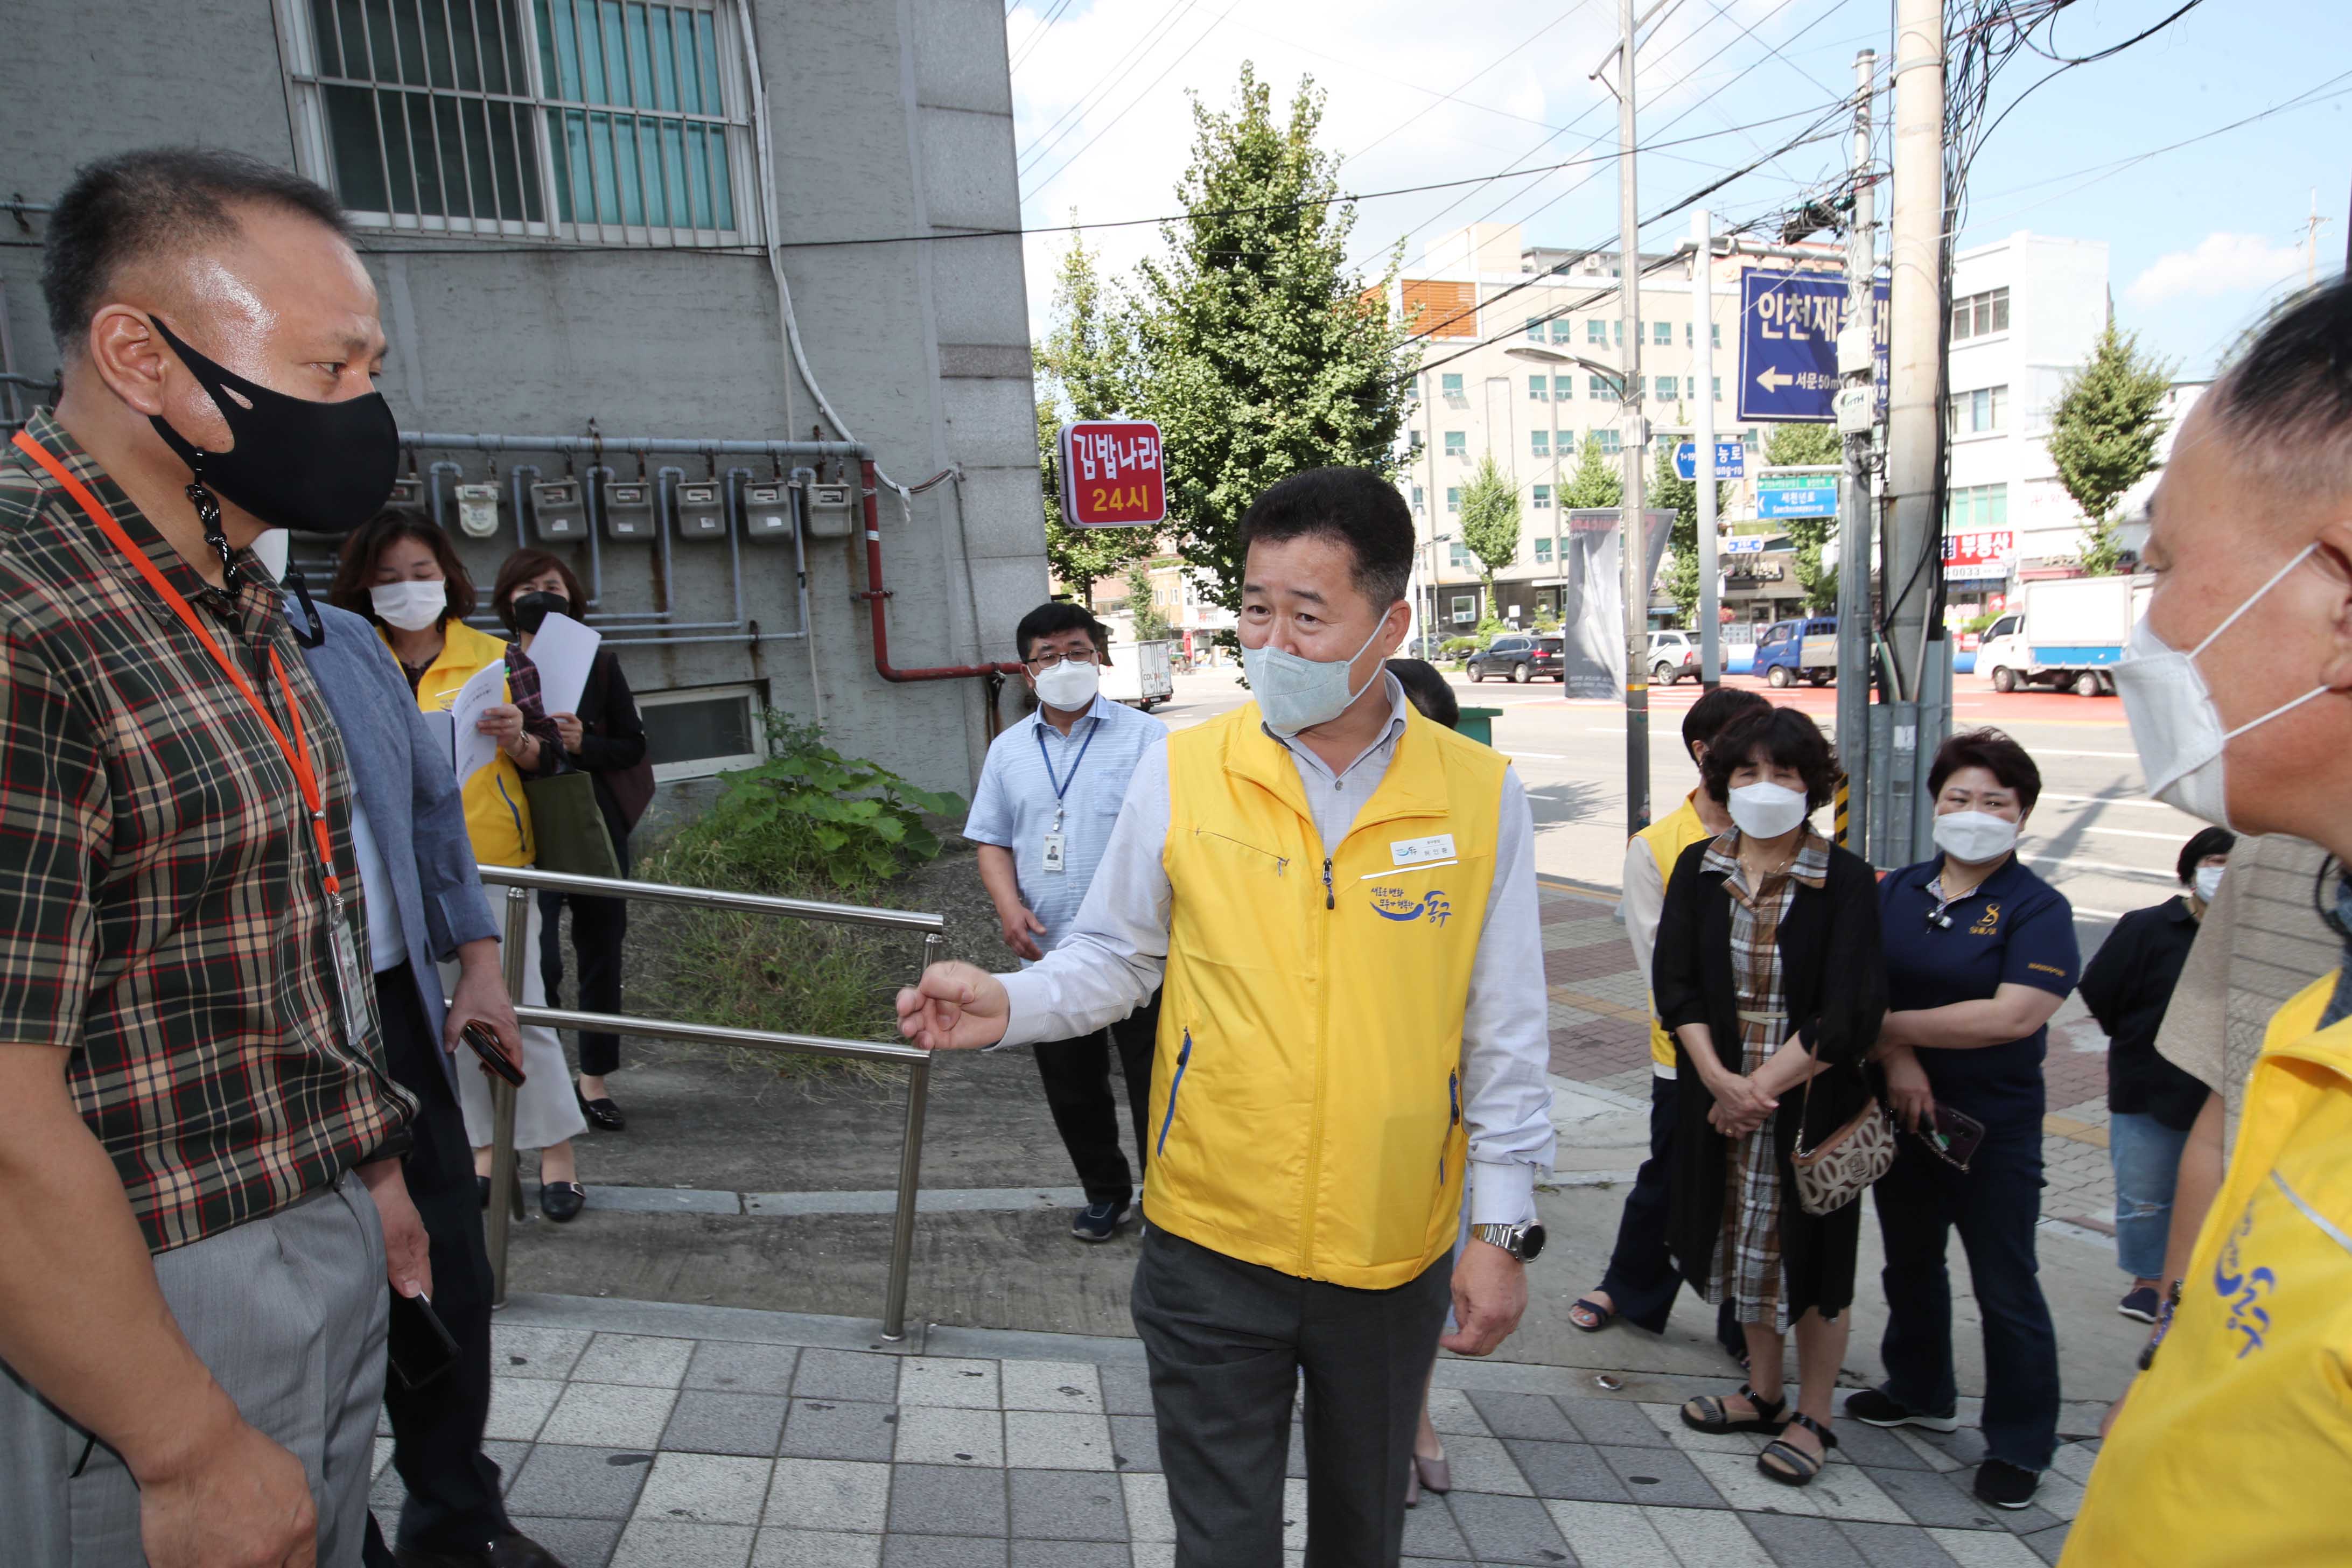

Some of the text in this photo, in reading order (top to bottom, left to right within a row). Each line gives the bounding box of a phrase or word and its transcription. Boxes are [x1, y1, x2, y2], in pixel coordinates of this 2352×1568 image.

[1758, 292, 1889, 345] 인천재대
[1796, 372, 1818, 390] 서문
[1073, 433, 1158, 480] 김밥나라
[1718, 446, 1742, 464] 능로
[1093, 485, 1149, 512] 24시
[1961, 533, 2010, 558] 부동산
[1370, 887, 1404, 898] 새로운 변화
[1380, 899, 1415, 912] 모두가 행복한
[1424, 890, 1452, 928] 동구
